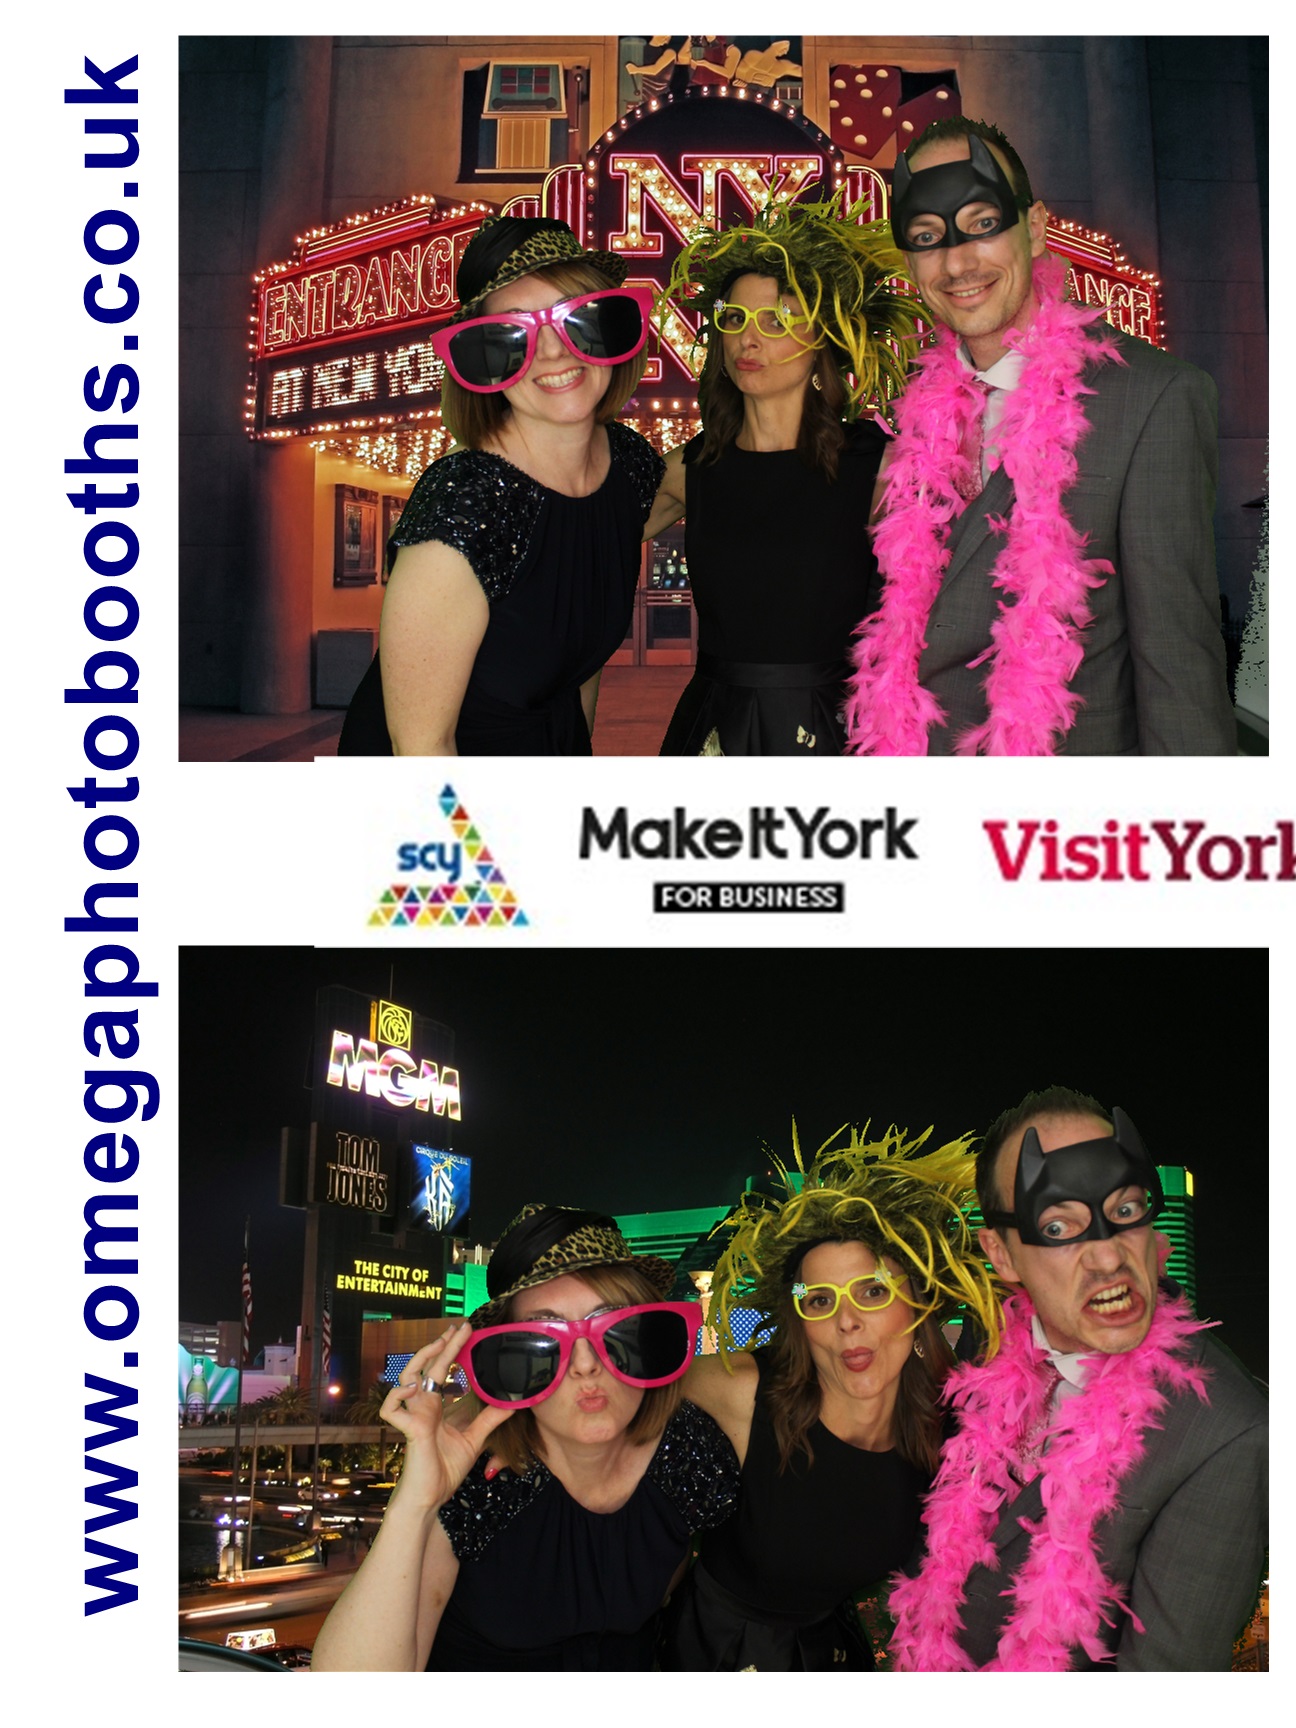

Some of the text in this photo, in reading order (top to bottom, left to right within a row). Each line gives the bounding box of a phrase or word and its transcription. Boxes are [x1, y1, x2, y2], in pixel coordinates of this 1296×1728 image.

[327, 1029, 462, 1121] MGM
[336, 1131, 381, 1172] TOM
[327, 1168, 388, 1213] JONES
[336, 1274, 442, 1300] ENTERTAINMENT
[354, 1260, 429, 1283] THE CITY OF
